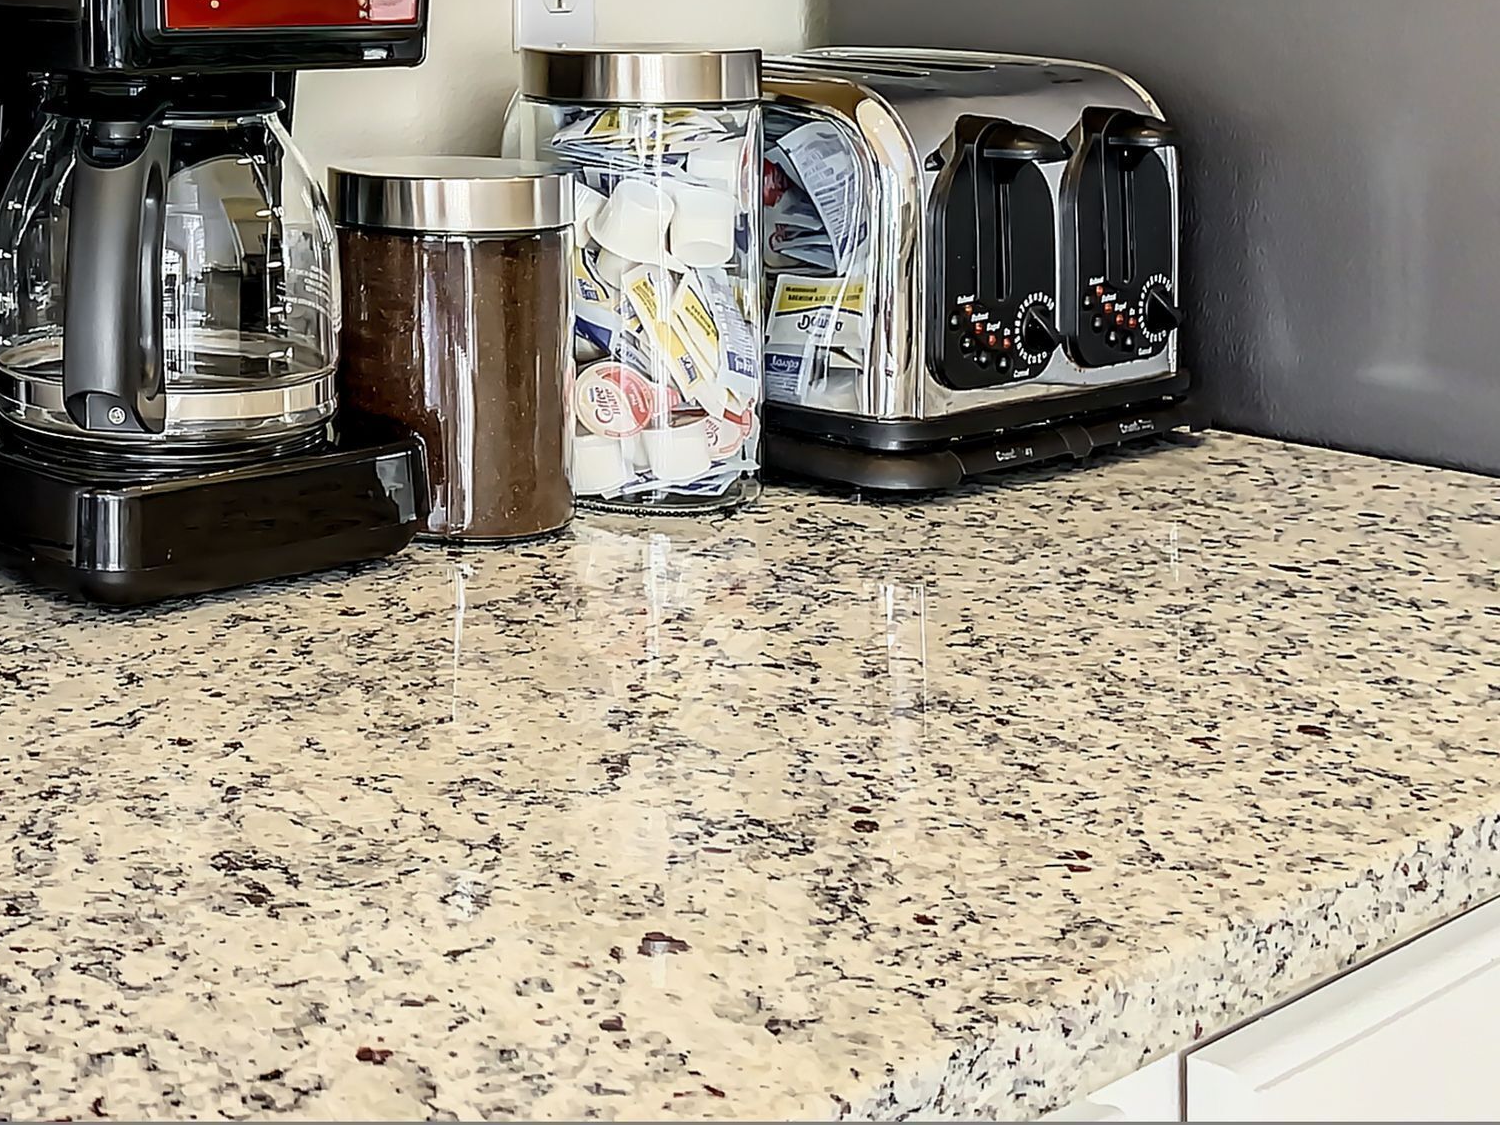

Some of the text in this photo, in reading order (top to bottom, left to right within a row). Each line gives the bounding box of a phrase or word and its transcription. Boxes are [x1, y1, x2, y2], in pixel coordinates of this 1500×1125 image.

[253, 154, 267, 164] 12
[272, 206, 285, 218] 10
[284, 302, 293, 314] 6
[595, 386, 614, 424] Coffee
